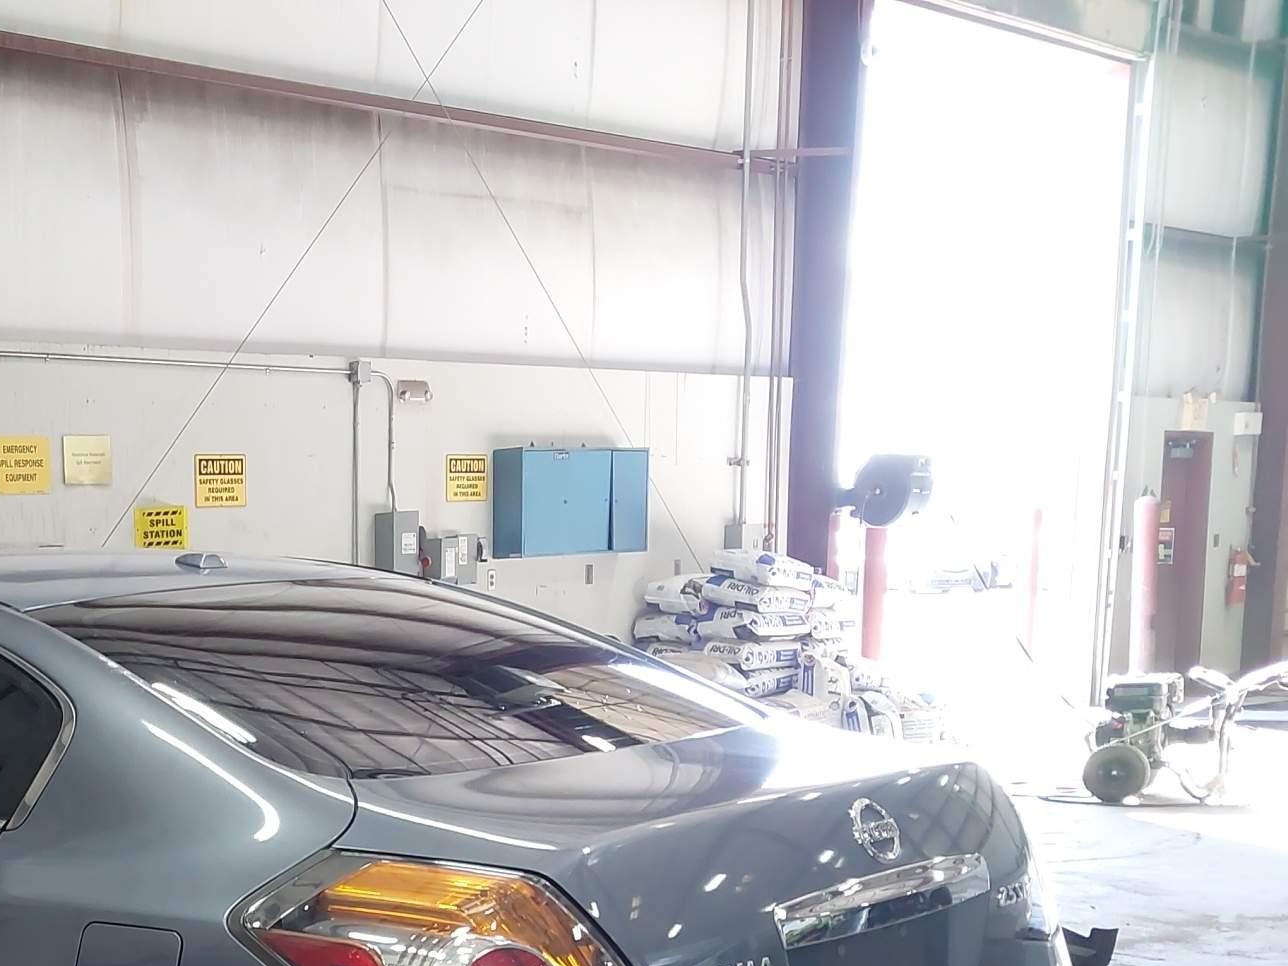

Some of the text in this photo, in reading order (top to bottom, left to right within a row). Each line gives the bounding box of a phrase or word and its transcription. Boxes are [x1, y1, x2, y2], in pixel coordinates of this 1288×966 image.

[2, 445, 38, 454] EMERGENCY
[14, 459, 44, 468] RESPONSE
[200, 460, 242, 474] CAUTION
[450, 460, 485, 473] CAUTION
[5, 473, 37, 482] EQUIPMENT
[149, 518, 176, 527] SPILL
[143, 529, 182, 539] STATION
